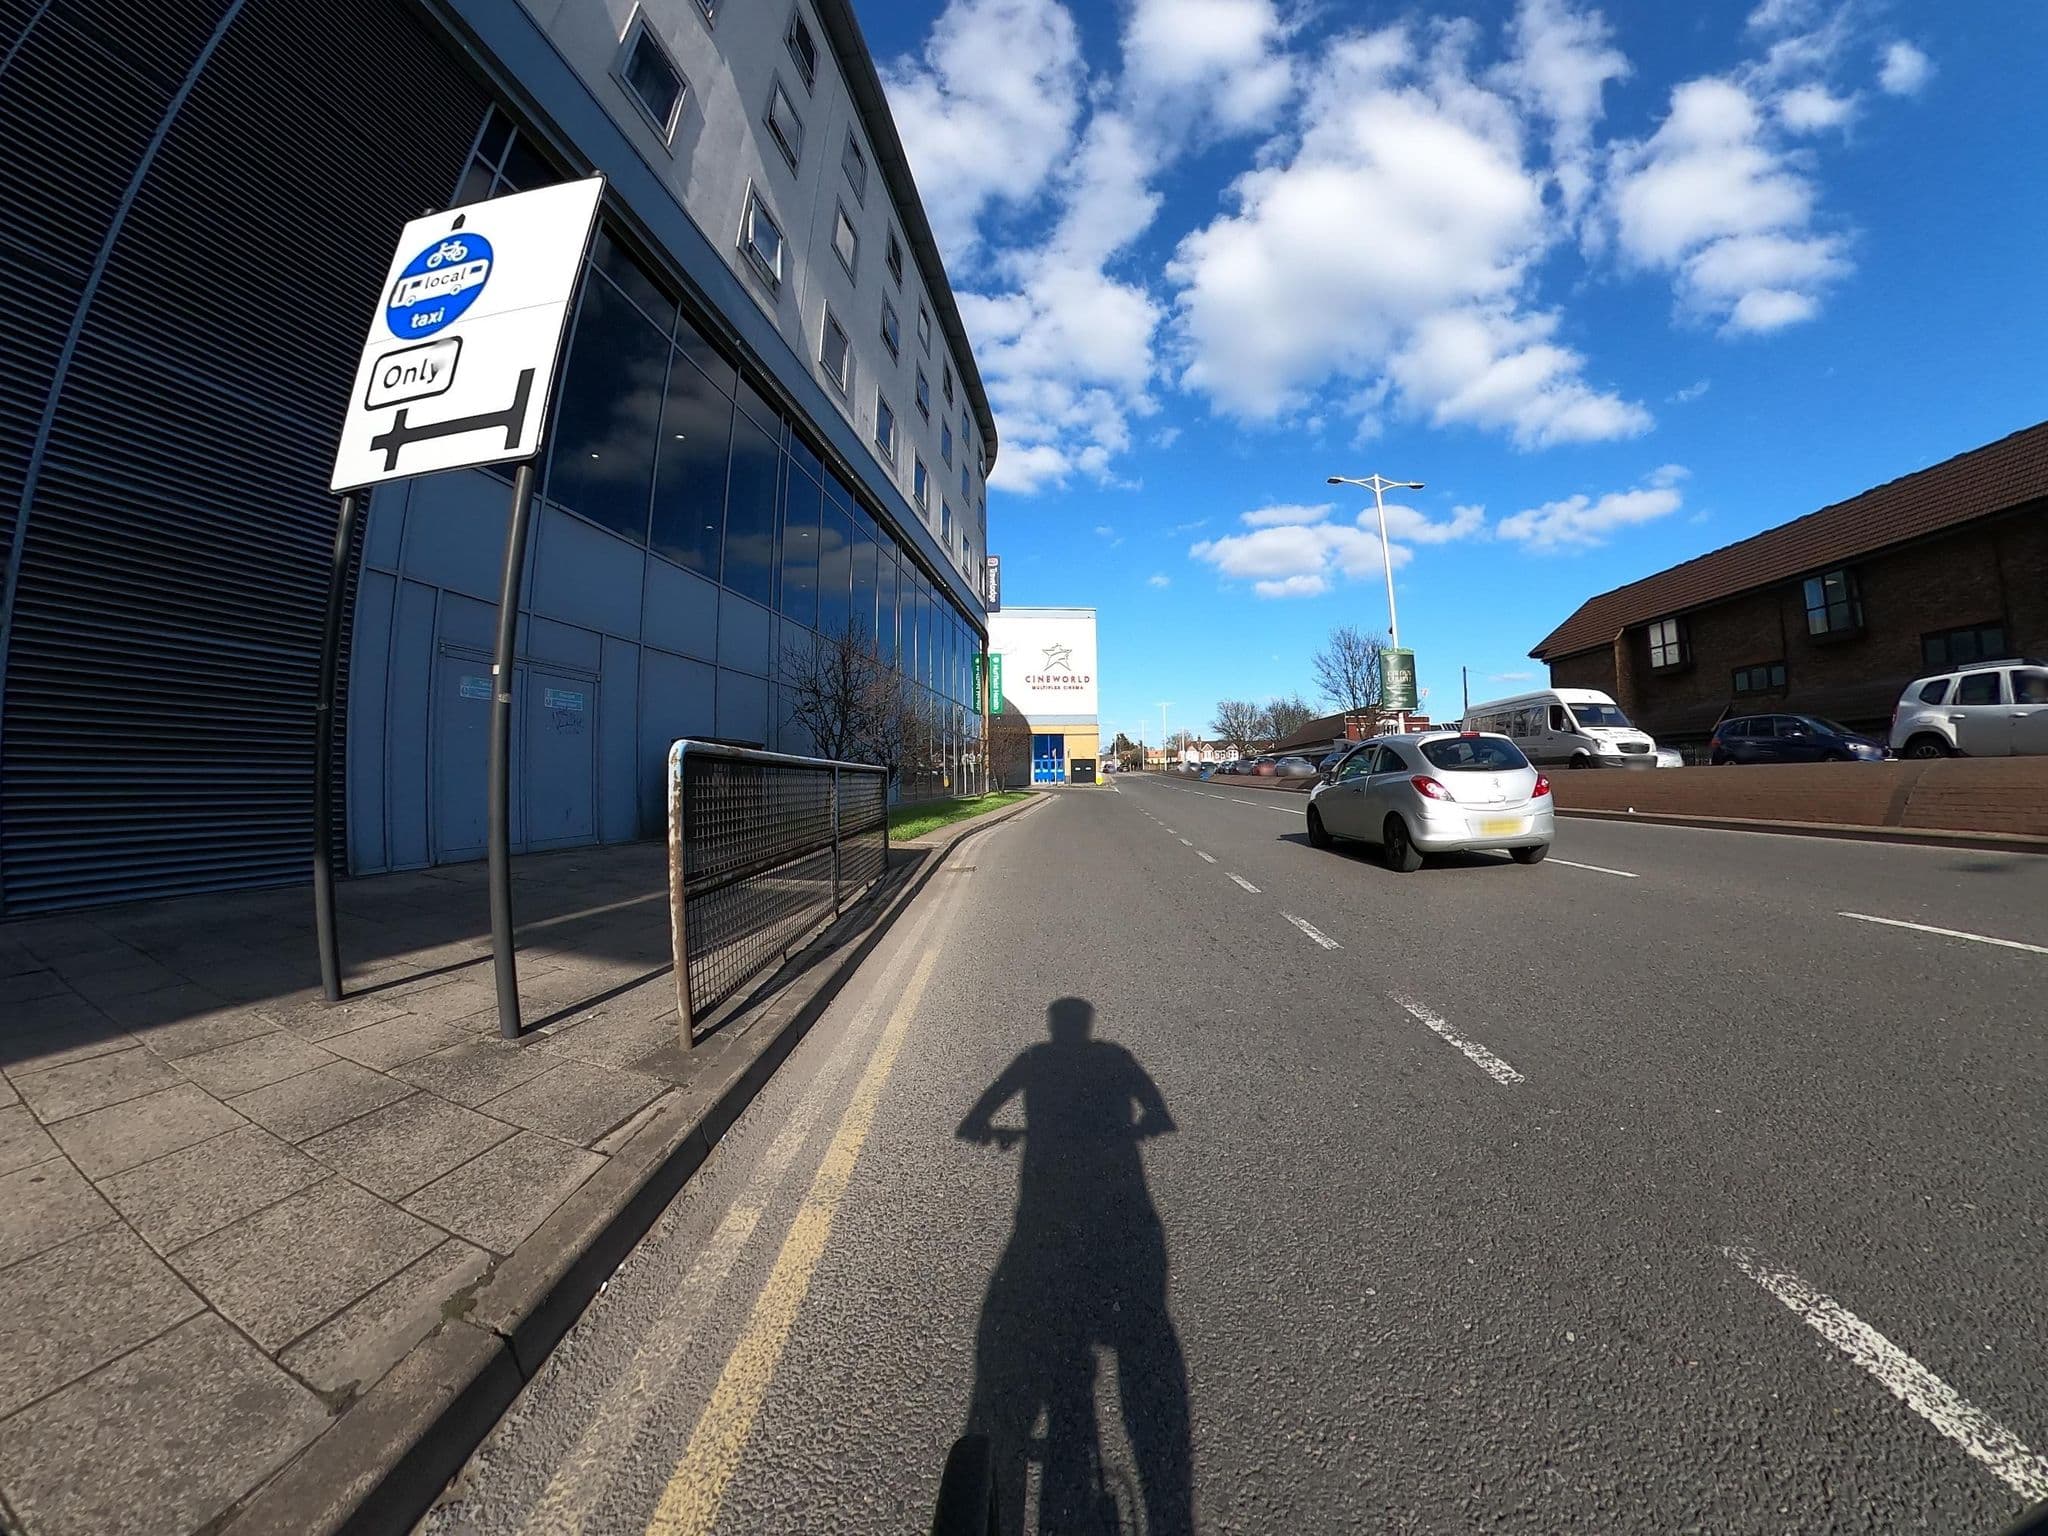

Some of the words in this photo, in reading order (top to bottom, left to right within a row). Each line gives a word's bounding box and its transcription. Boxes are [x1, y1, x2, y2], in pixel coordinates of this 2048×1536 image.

[424, 267, 466, 290] local
[411, 306, 445, 329] taxi
[383, 358, 440, 389] Only
[1025, 675, 1090, 683] CINEWORLD
